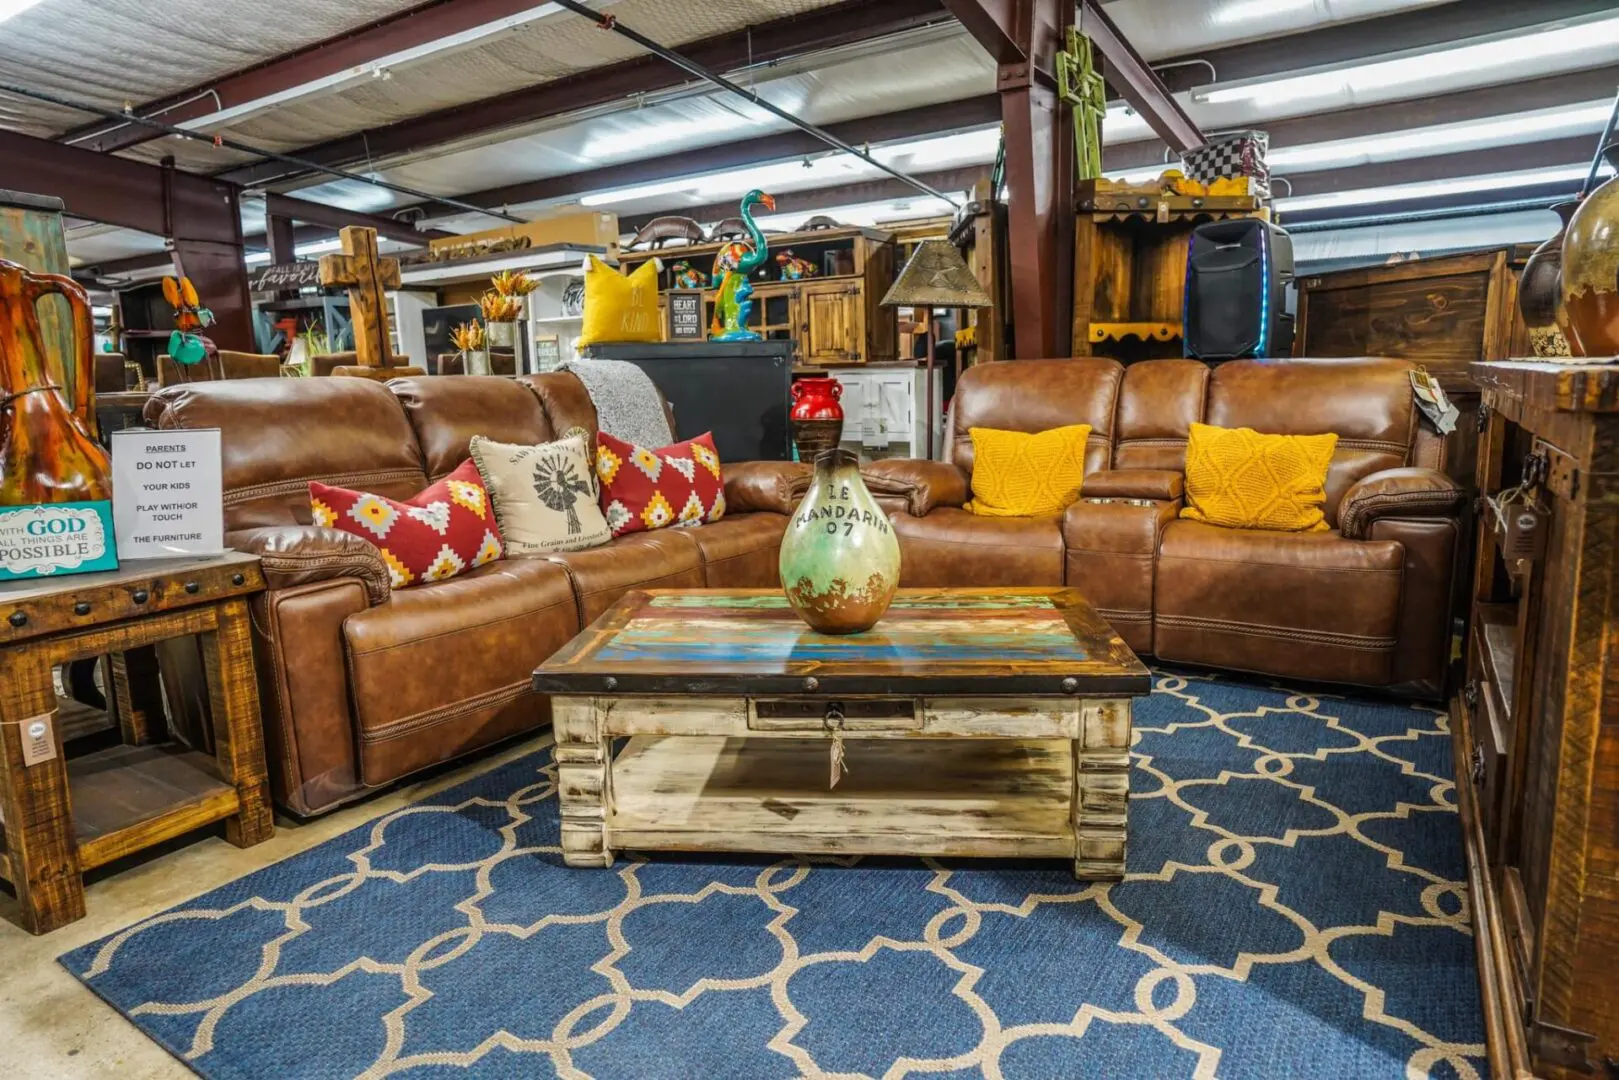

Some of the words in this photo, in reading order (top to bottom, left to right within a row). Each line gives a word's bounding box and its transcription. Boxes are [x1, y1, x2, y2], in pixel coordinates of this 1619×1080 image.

[673, 299, 696, 310] HEART
[679, 314, 698, 324] LORD
[145, 445, 187, 454] PARENTS
[136, 461, 153, 470] DO
[156, 460, 178, 469] NOT
[180, 461, 196, 469] LET
[143, 483, 168, 491] YOUR
[170, 482, 191, 490] KIDS
[136, 504, 159, 512] PLAY
[152, 514, 183, 522] TOUCH
[796, 504, 888, 535] MANDARIN
[27, 517, 86, 536] GOD
[21, 534, 63, 545] THINGS
[66, 532, 88, 541] ARE
[133, 535, 151, 544] THE
[153, 532, 202, 542] FURNITURE
[541, 538, 564, 548] Grains
[565, 537, 577, 545] and
[0, 542, 89, 562] POSSIBLE
